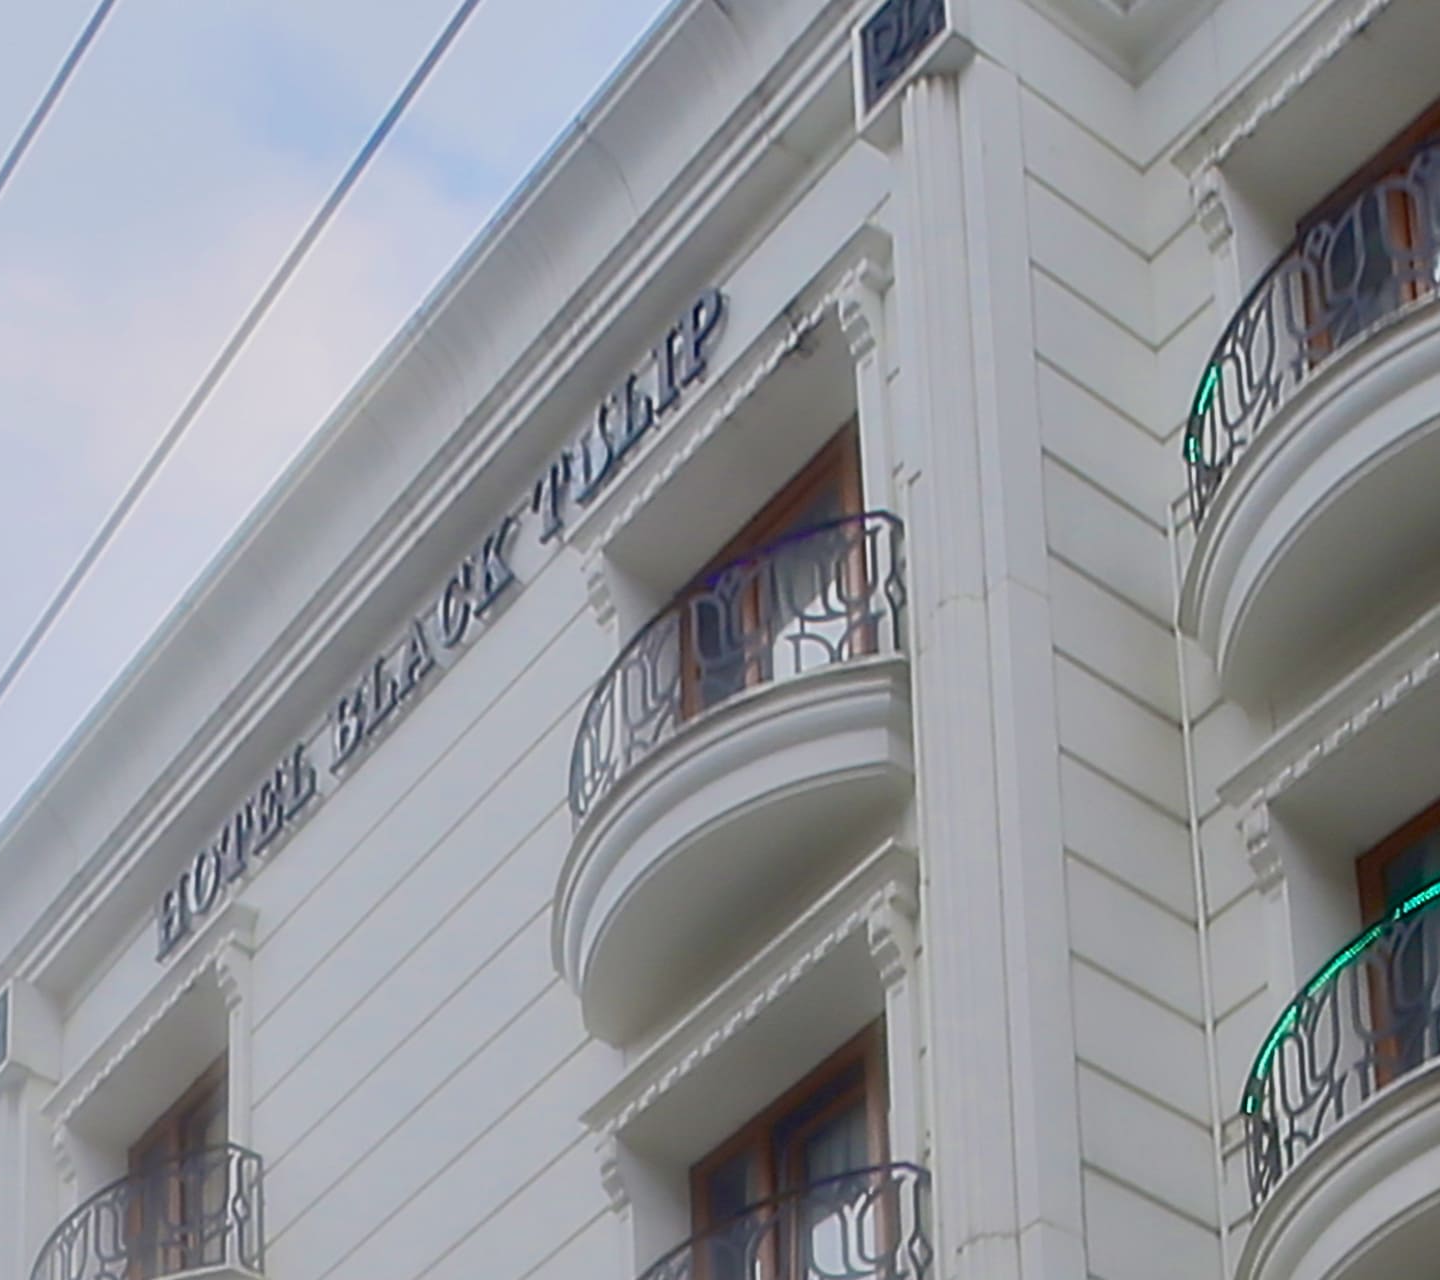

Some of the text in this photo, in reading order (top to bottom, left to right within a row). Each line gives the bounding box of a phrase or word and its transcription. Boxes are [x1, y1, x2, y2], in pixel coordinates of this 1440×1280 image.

[154, 286, 727, 963] HOTEL BLACK TULIP
